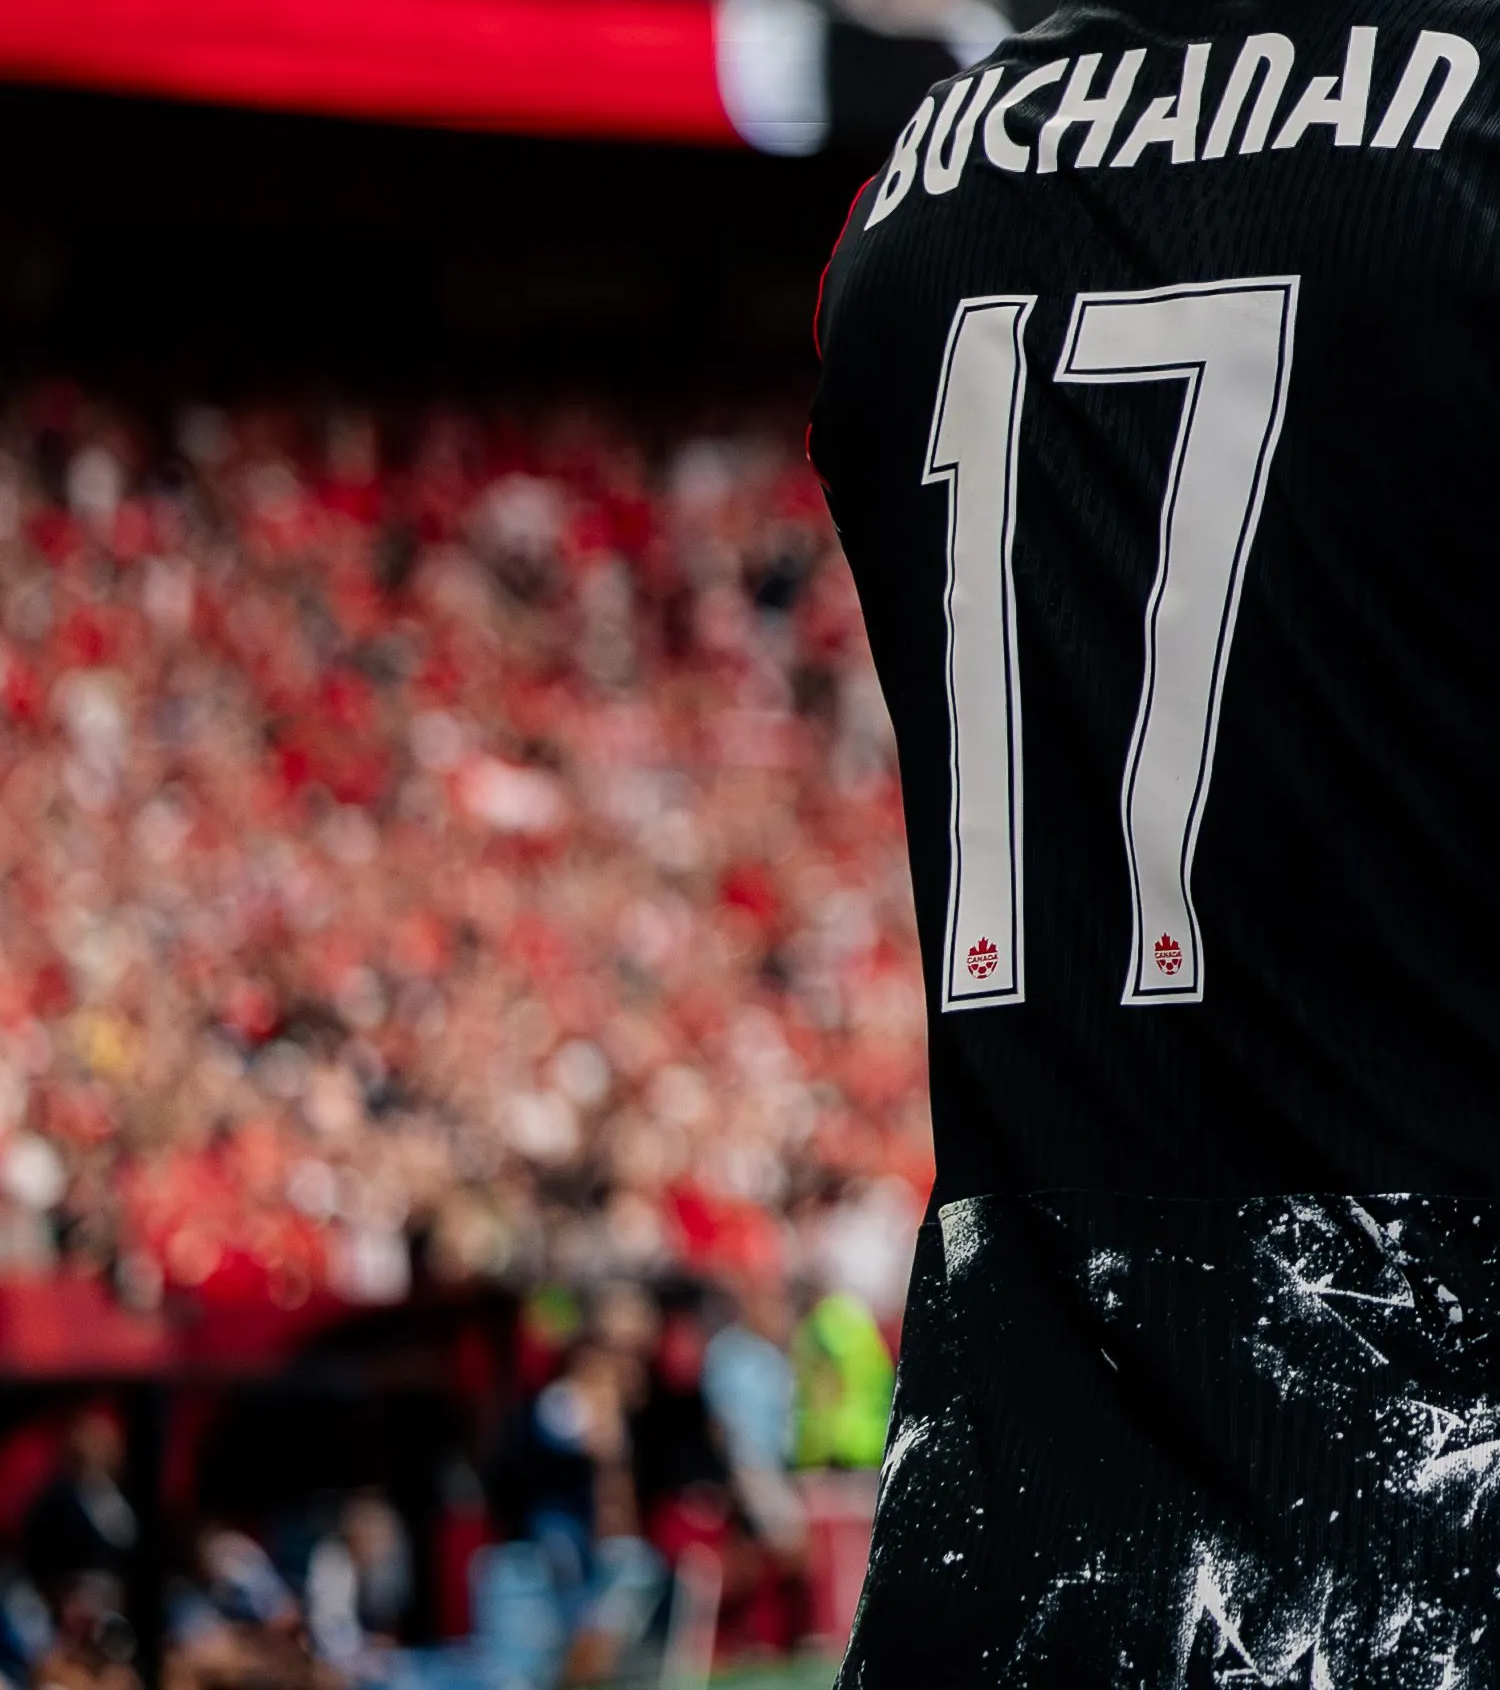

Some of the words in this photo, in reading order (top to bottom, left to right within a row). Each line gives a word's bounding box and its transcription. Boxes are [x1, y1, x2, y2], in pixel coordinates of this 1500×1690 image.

[864, 25, 1481, 231] BUCHANAN
[922, 275, 1300, 1012] 17
[967, 954, 998, 965] CANADA
[1154, 951, 1182, 960] CANADA
